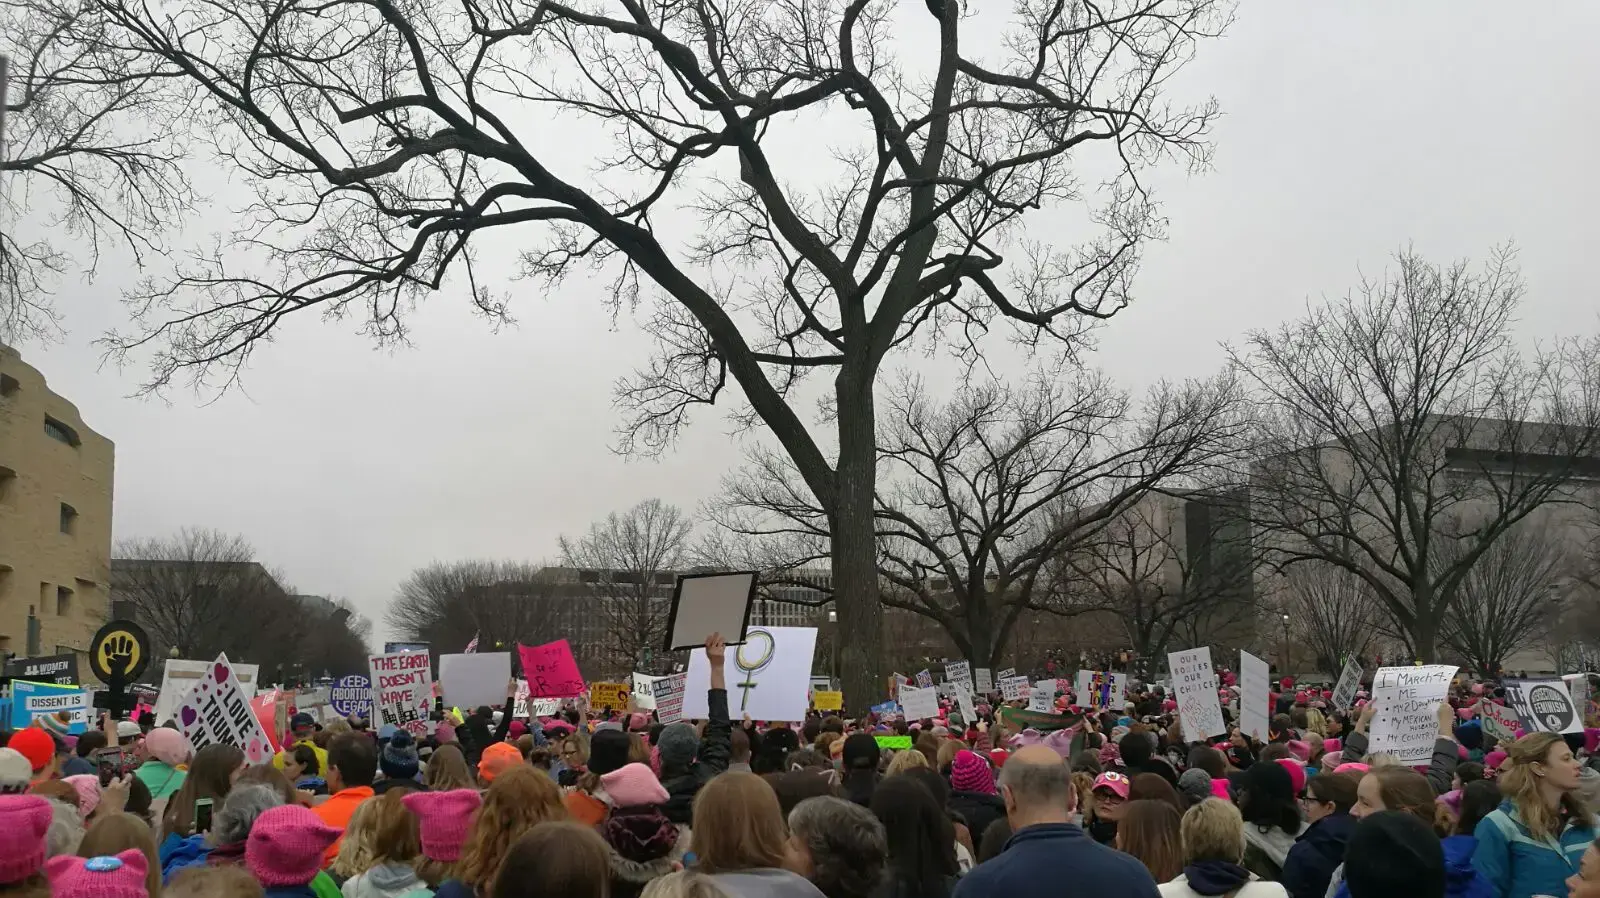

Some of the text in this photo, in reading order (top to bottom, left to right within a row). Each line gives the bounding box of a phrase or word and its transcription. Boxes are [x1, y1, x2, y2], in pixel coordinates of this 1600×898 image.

[371, 654, 429, 670] THE EARTH
[1180, 655, 1198, 664] OUR
[40, 661, 69, 673] WOMEN
[1174, 662, 1208, 676] BODIES
[340, 675, 369, 688] KEEP
[380, 669, 426, 688] DOESN'T
[1184, 673, 1202, 683] OUR
[1377, 672, 1395, 689] I
[1180, 681, 1214, 694] CHOICE
[1399, 688, 1418, 700] ME
[32, 696, 81, 707] DISSENT IS
[381, 689, 413, 705] HAVE
[418, 698, 430, 713] 4
[1534, 700, 1568, 713] FEMINISM
[223, 687, 254, 740] LOVE
[1403, 714, 1432, 726] MEXICAN
[1401, 731, 1436, 743] COUNTRY
